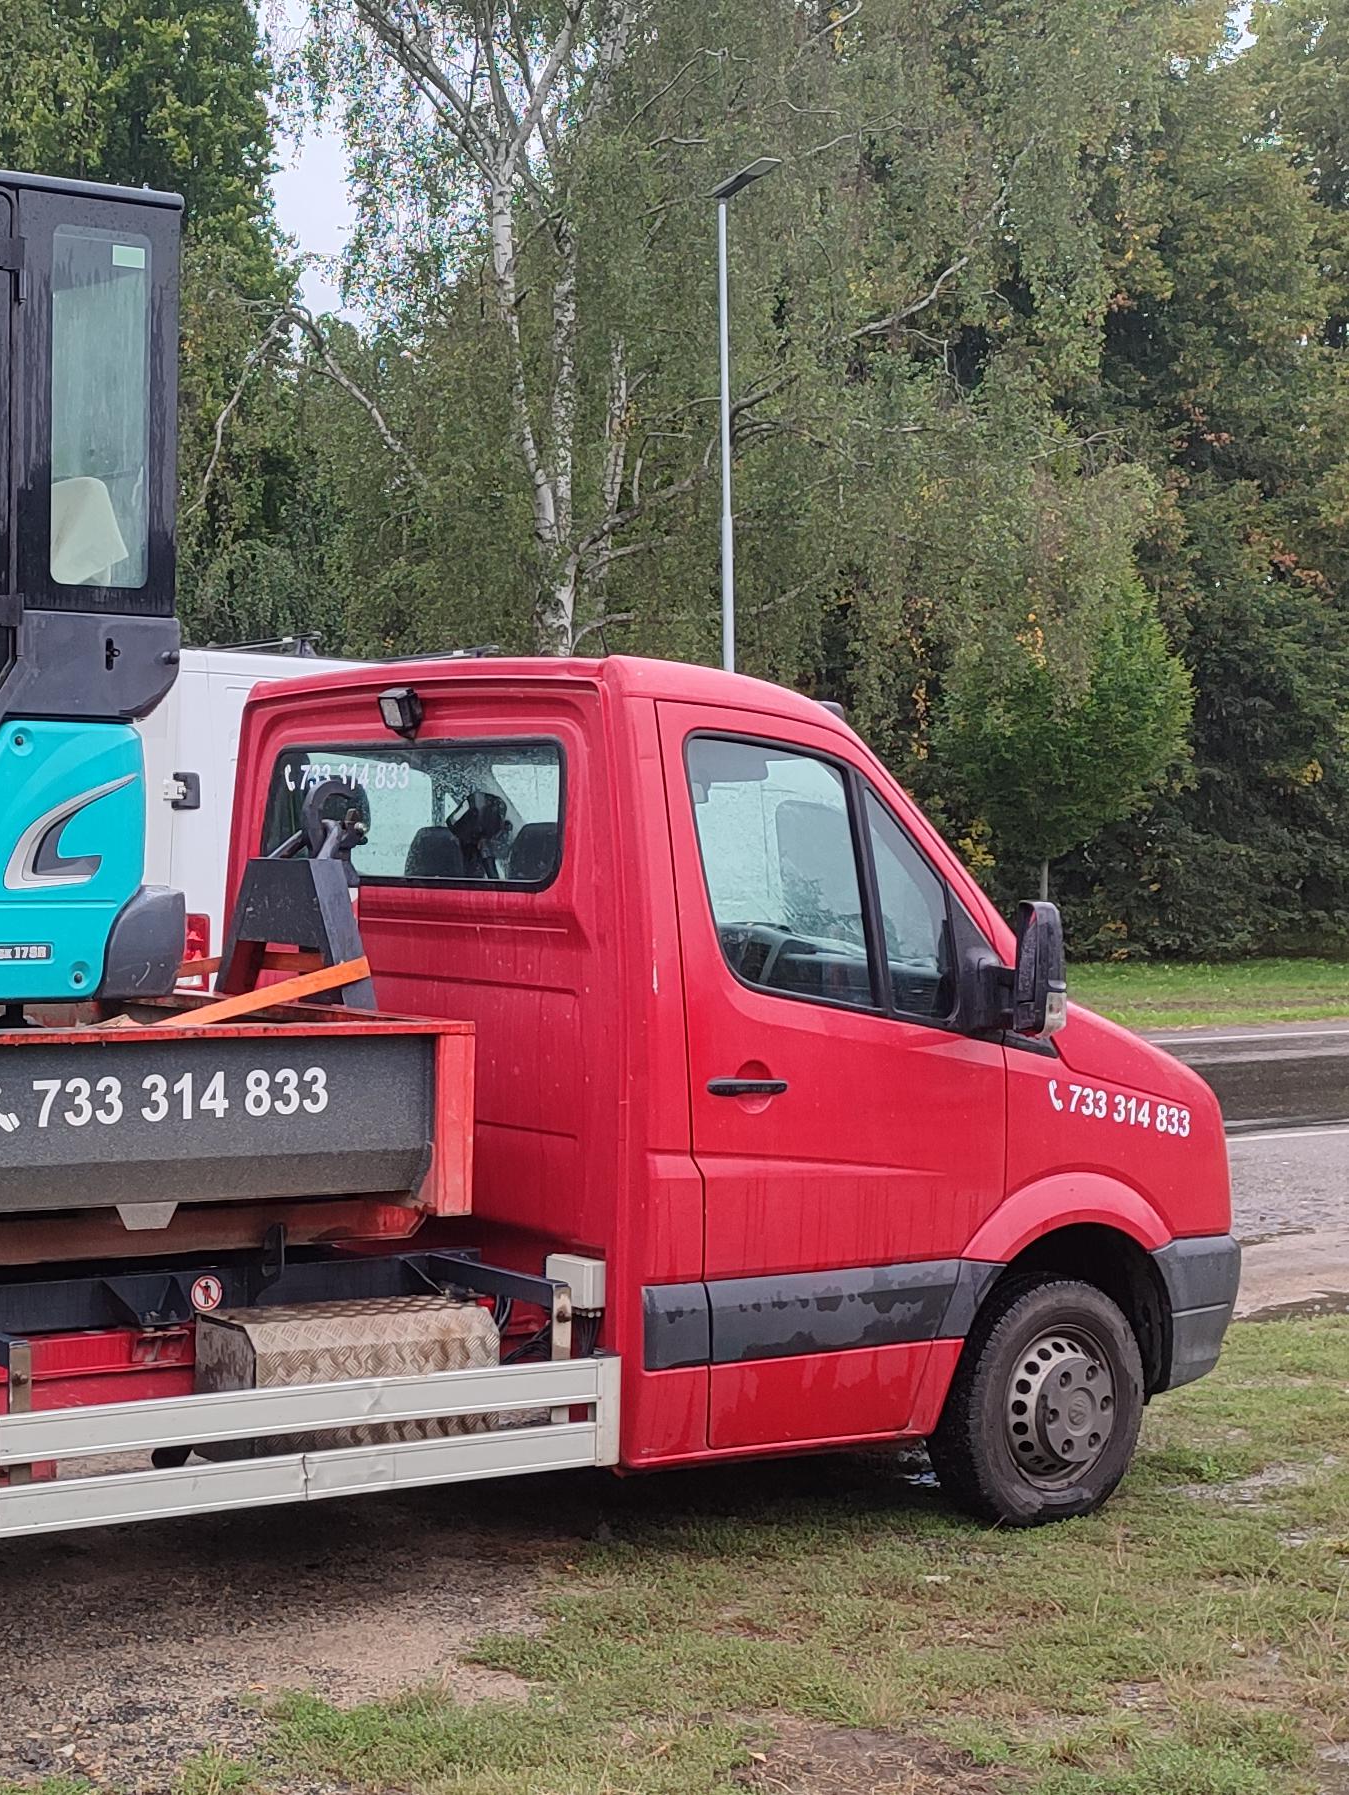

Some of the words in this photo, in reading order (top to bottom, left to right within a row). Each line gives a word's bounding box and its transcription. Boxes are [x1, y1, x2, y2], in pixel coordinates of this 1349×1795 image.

[300, 764, 332, 790] 733
[338, 763, 370, 790] 314
[375, 762, 411, 790] 833
[32, 1076, 124, 1128] 733
[140, 1070, 230, 1122] 314
[244, 1066, 329, 1117] 833
[1068, 1084, 1108, 1119] 733
[1112, 1094, 1152, 1129] 314
[1155, 1103, 1191, 1138] 833
